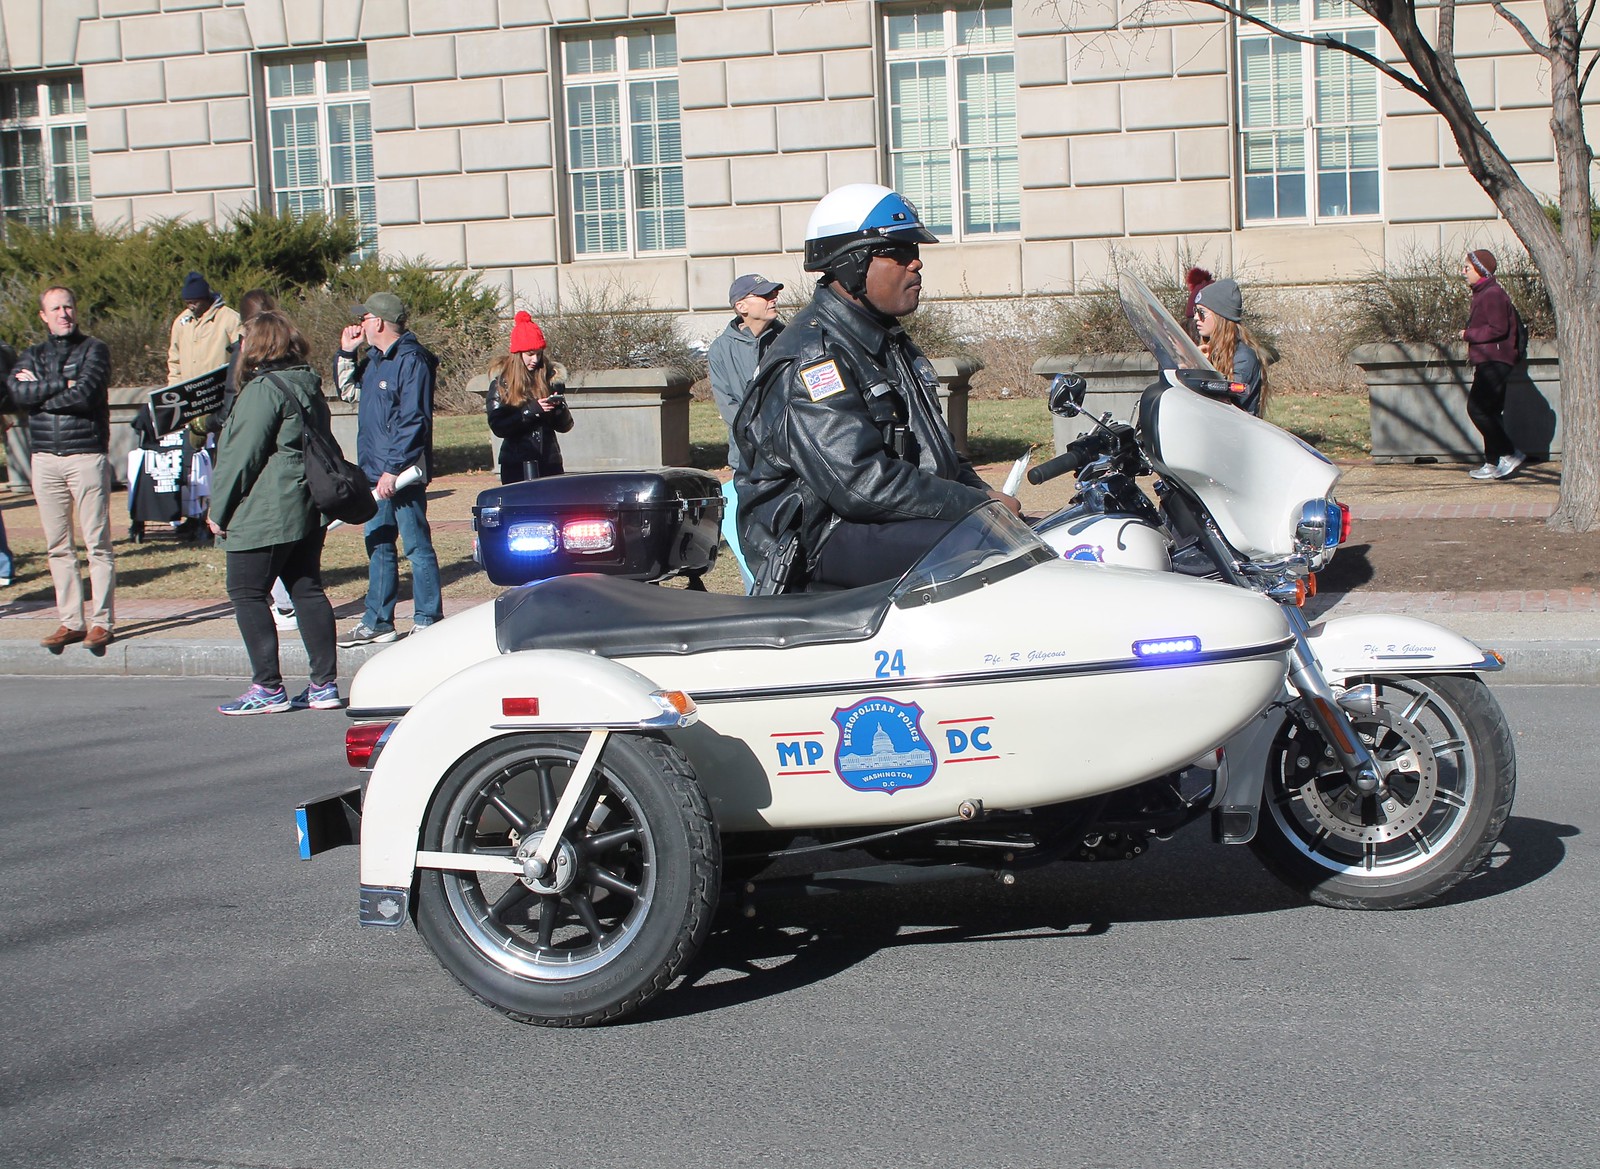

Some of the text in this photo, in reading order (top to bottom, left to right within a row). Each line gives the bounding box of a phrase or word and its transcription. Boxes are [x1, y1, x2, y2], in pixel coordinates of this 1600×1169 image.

[184, 376, 214, 392] Women
[808, 375, 820, 384] DC
[191, 394, 217, 408] Better
[183, 408, 203, 418] than
[1027, 650, 1066, 662] Gilgeous
[1402, 644, 1437, 654] Gilgeous
[874, 649, 906, 678] 24
[843, 703, 920, 747] METROPOLITAN POLICE
[946, 726, 993, 754] DC
[776, 741, 824, 767] MP
[862, 771, 913, 783] WASHINGTON
